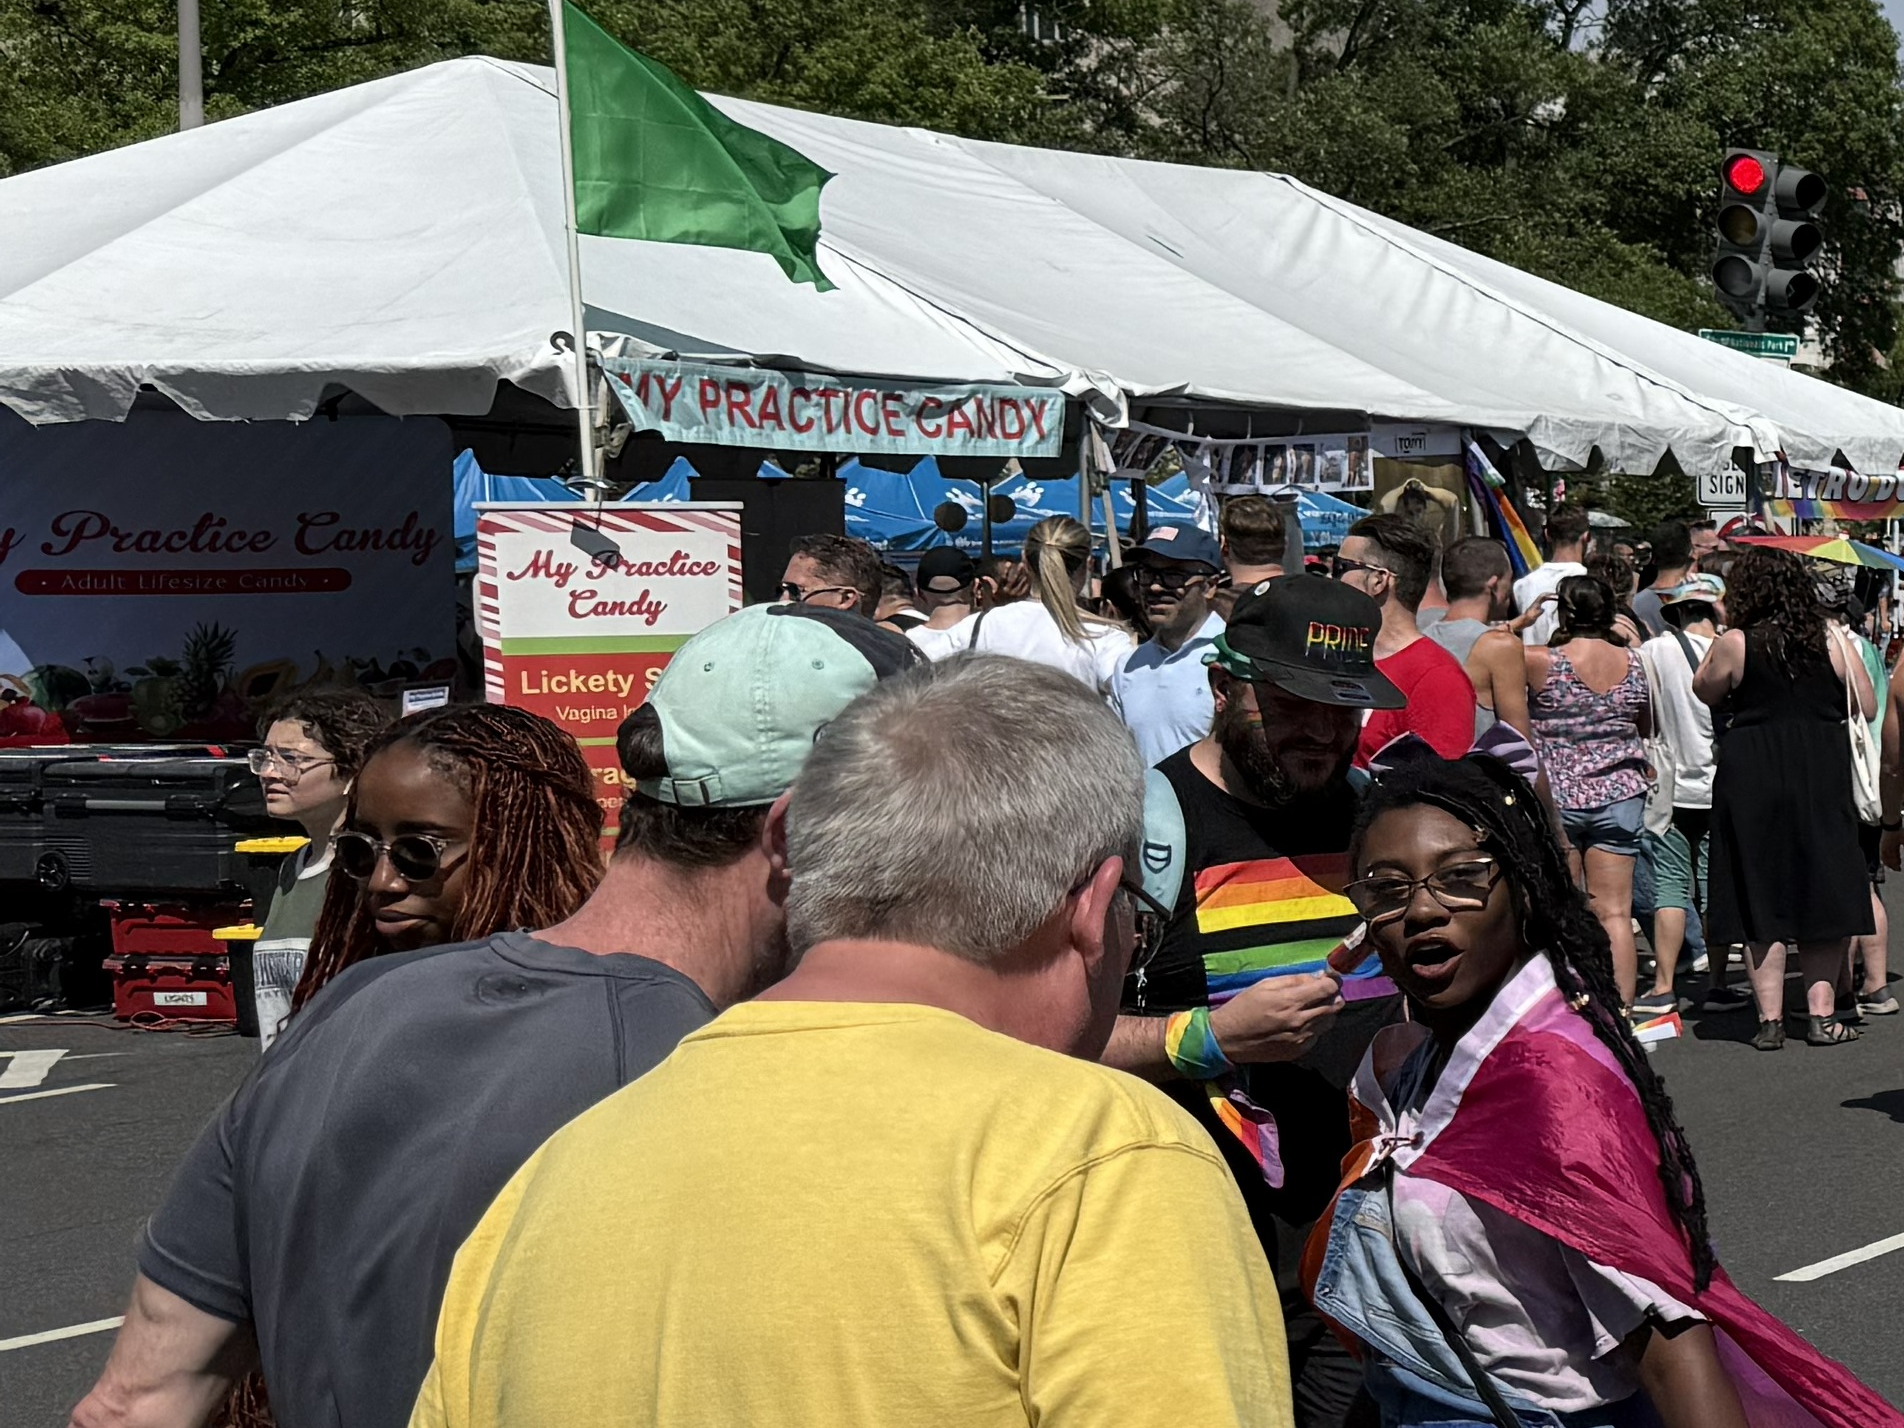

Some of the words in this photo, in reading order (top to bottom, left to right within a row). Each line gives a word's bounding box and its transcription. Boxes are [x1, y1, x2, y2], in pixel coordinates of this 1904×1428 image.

[618, 371, 682, 423] MY
[699, 378, 906, 439] PRACTICE
[915, 395, 1049, 441] CANDY
[1709, 474, 1745, 496] SIGN
[41, 509, 280, 557] Practice
[294, 510, 443, 566] Candy
[61, 573, 127, 590] Adult
[139, 573, 228, 590] Lifesize
[239, 572, 310, 591] Candy
[506, 548, 579, 589] My
[567, 588, 668, 627] Candy
[1305, 621, 1371, 664] PRIDE
[521, 668, 635, 698] Lickety
[556, 705, 618, 724] Vagina
